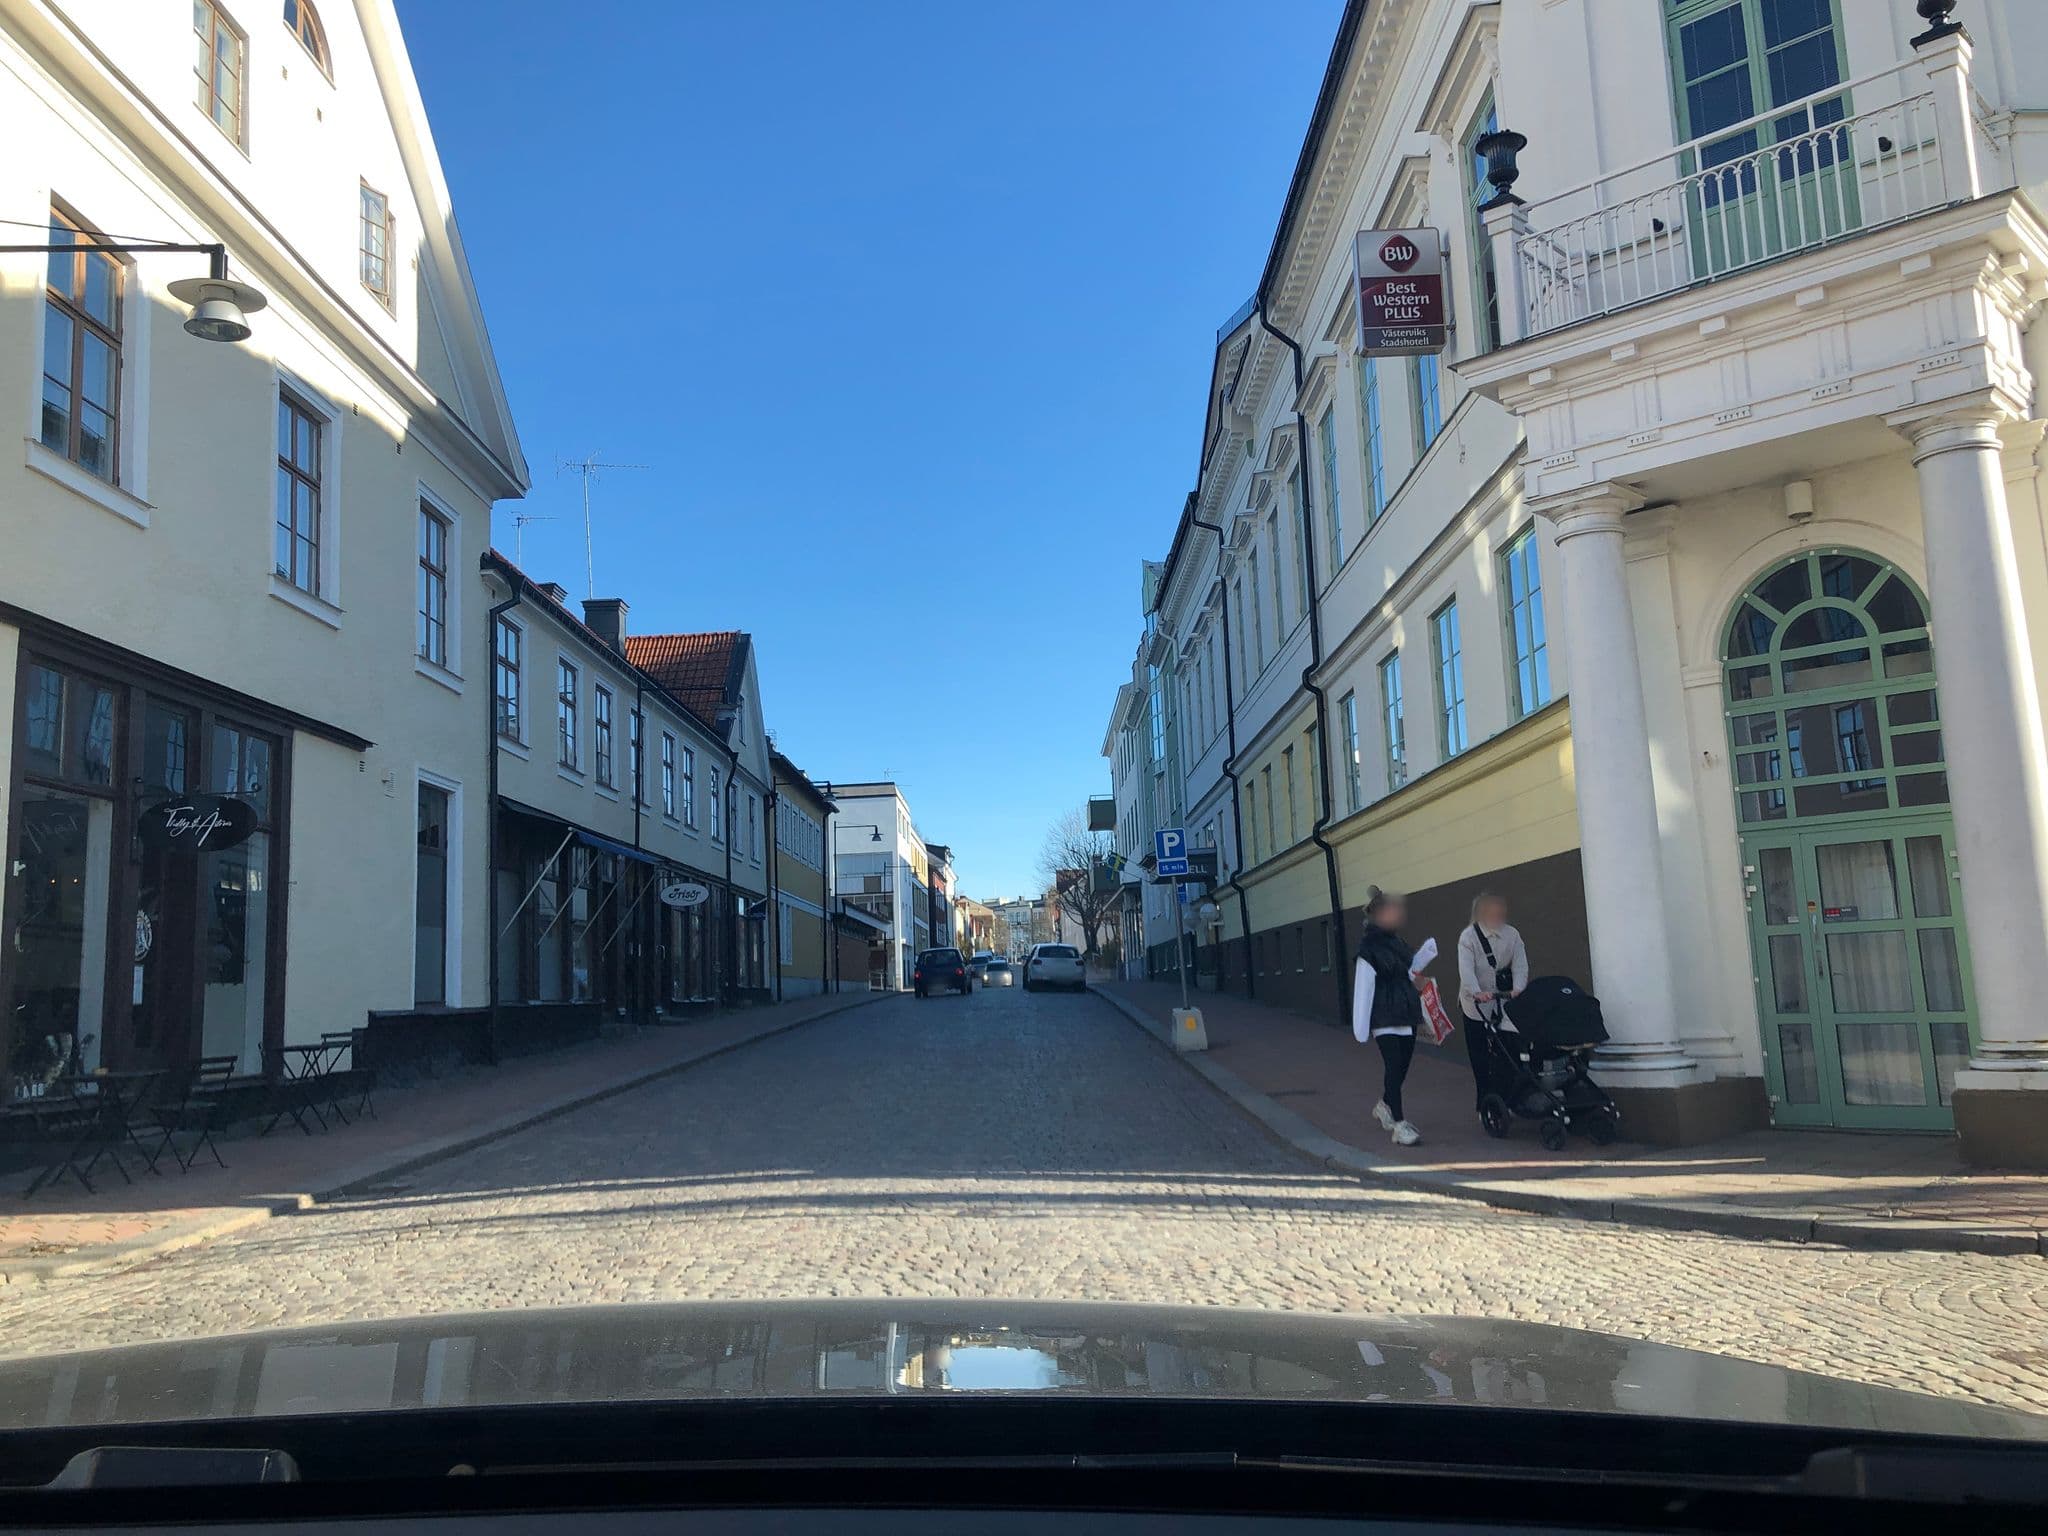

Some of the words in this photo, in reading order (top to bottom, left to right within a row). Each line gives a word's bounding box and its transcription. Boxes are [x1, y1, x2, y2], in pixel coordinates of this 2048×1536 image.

[1384, 246, 1413, 261] BW
[1386, 282, 1417, 294] Best
[1373, 295, 1430, 306] Western
[1385, 306, 1421, 319] PLUS
[1382, 328, 1427, 337] Västerviks
[1380, 338, 1429, 347] Stadshotell
[1162, 832, 1180, 857] P
[668, 888, 701, 902] Frisör
